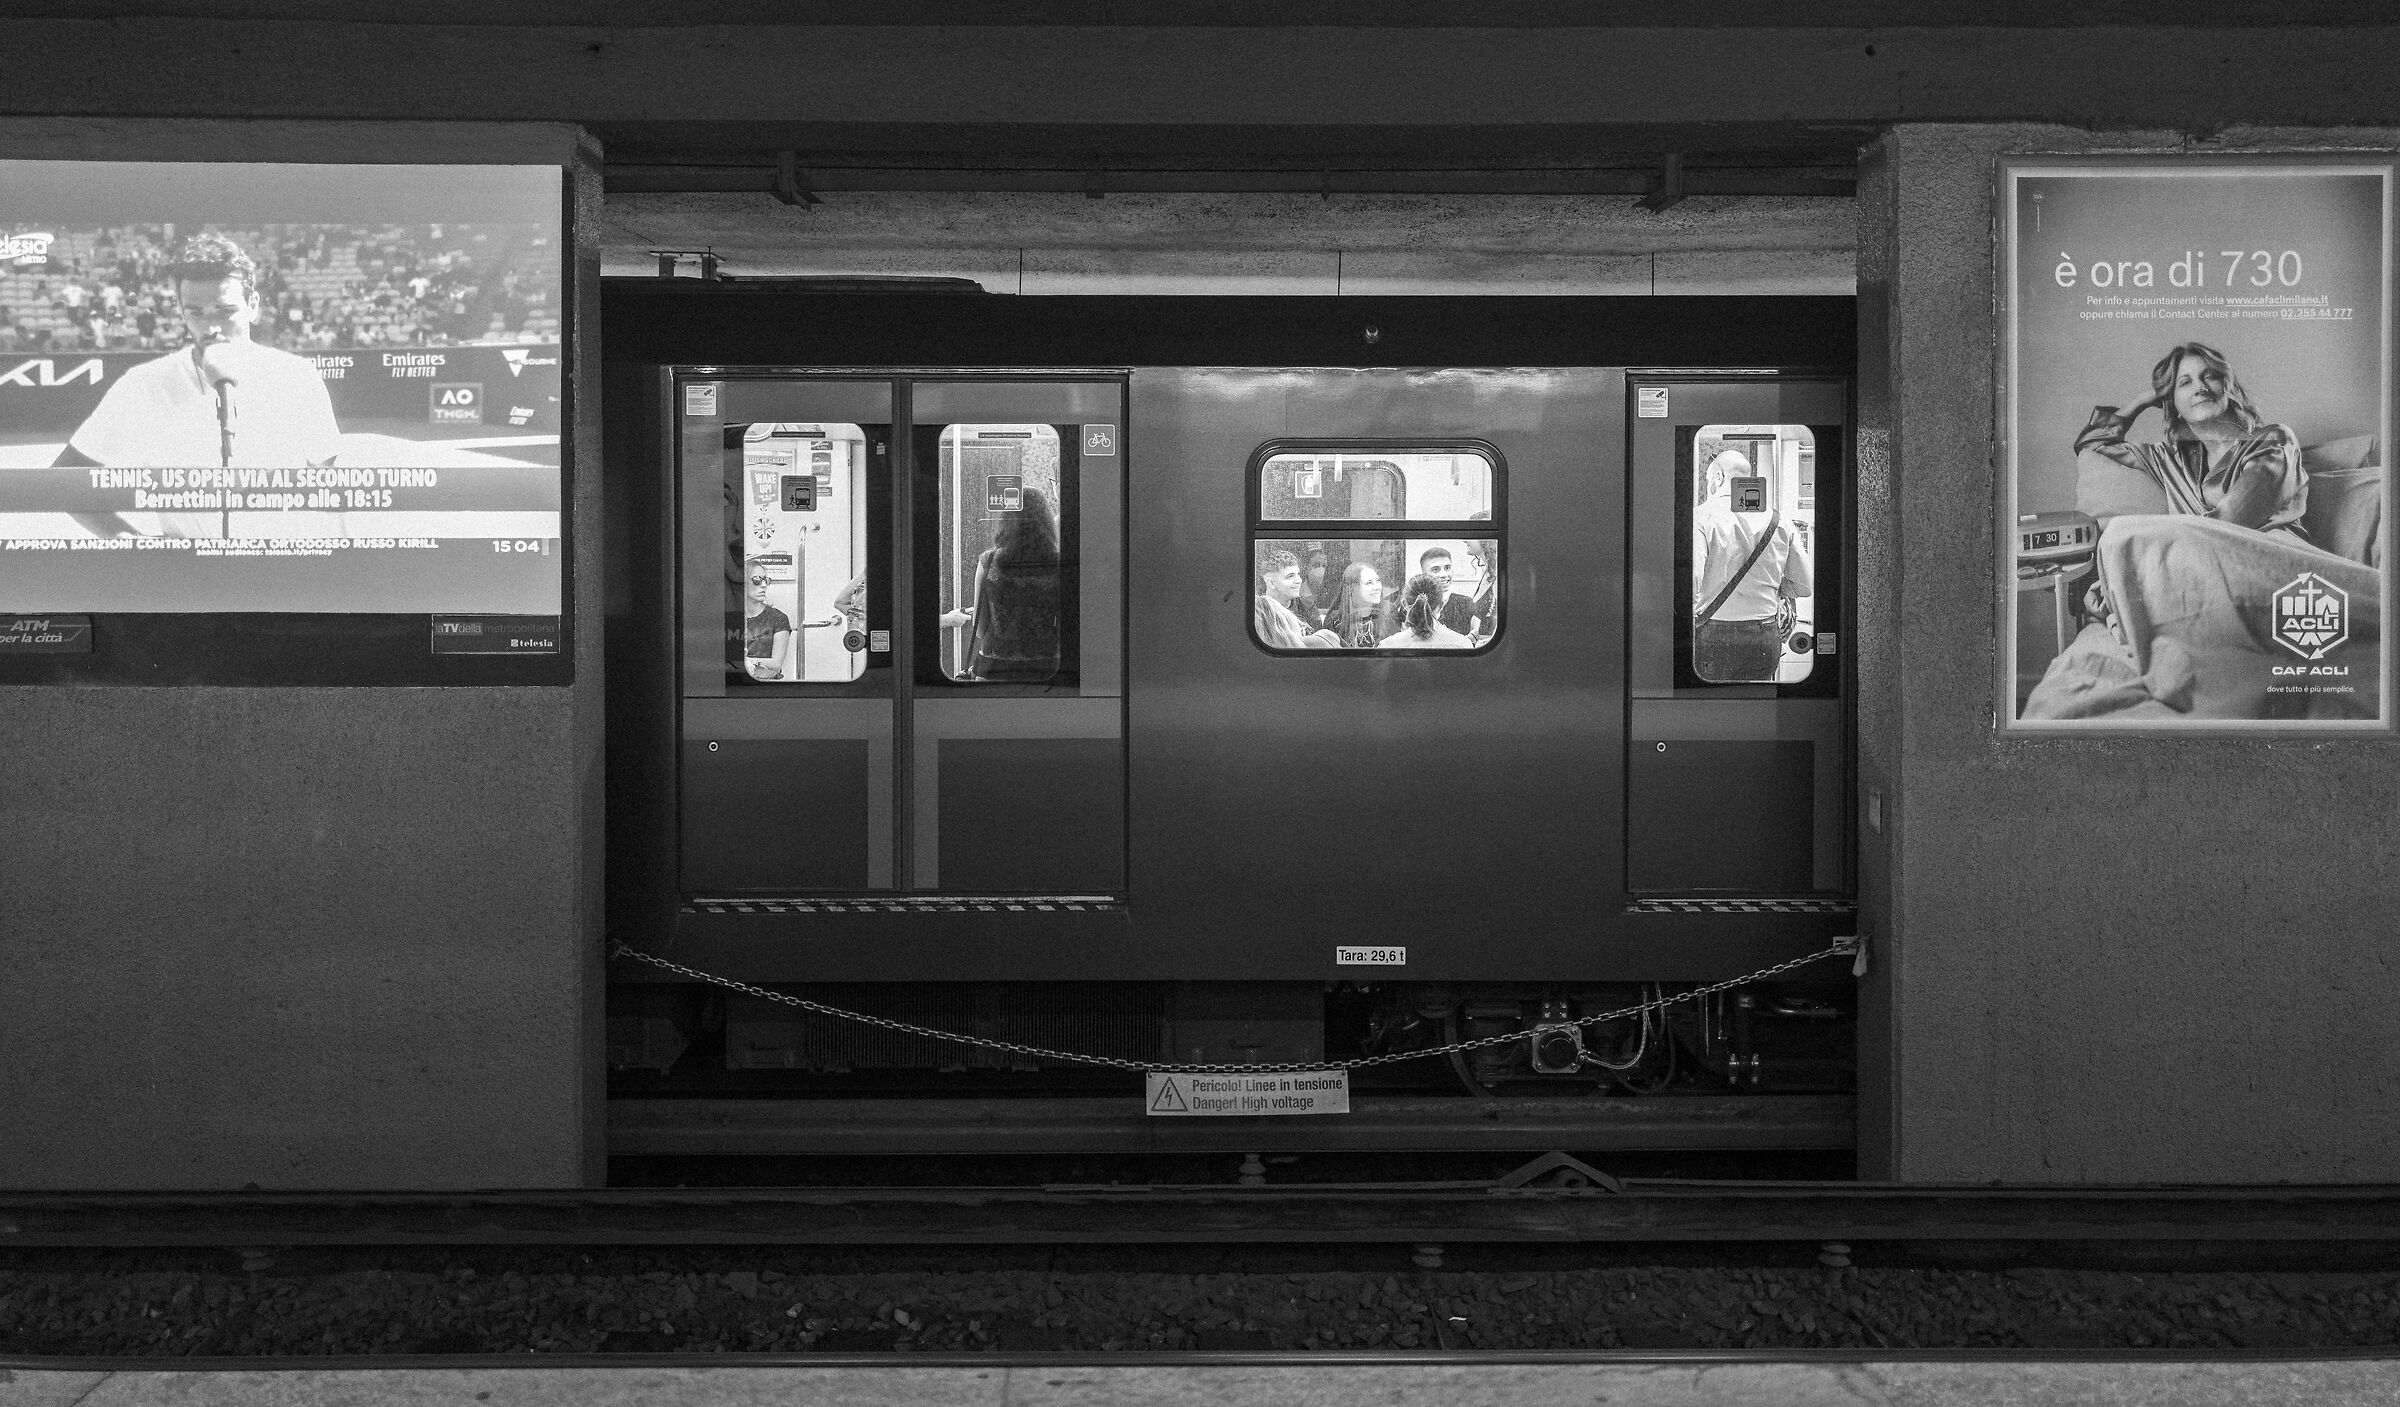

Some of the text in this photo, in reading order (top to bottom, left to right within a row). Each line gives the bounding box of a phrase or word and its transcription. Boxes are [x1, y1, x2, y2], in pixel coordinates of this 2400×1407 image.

[2054, 250, 2302, 287] è ora di 730
[2086, 295, 2102, 305] Per
[2104, 295, 2122, 305] info
[2132, 296, 2197, 307] appuntamenti
[2199, 295, 2224, 305] visita
[2226, 294, 2328, 306] www.cafaclimilano.it
[2080, 311, 2113, 320] oppure
[2115, 309, 2149, 319] chiama
[2151, 309, 2157, 318] il
[2158, 309, 2195, 318] Contact
[2197, 308, 2228, 318] Center
[2242, 310, 2279, 318] numero
[2280, 308, 2316, 318] 02.255
[2318, 308, 2331, 317] 44
[2333, 308, 2353, 317] 777
[382, 352, 446, 366] Emirates
[392, 367, 406, 378] FLY
[89, 468, 437, 490] TENNIS, US OPEN VIA AL SECONDO TURNO
[135, 488, 393, 512] Berrettini in campo alle 18:15
[5, 538, 439, 550] APPROVA SANZIONI CONTRO PATRIARCA ORTODOSSO RUSSO KIRILL
[2035, 533, 2057, 544] 7 30
[492, 540, 540, 553] 15 04
[10, 620, 50, 632] ATM
[484, 623, 555, 635] metropolitana
[2282, 617, 2339, 630] ACLI
[21, 633, 32, 643] la
[35, 632, 63, 643] città
[519, 638, 553, 648] telesia
[2271, 666, 2349, 676] CAF ACLI
[2266, 685, 2355, 694] dove tutto è più semplice.
[1338, 950, 1404, 964] Tara: 29,6 t
[1192, 1078, 1343, 1092] Pericolo! Linee in tensione
[1192, 1096, 1314, 1111] Danger! High voltage
